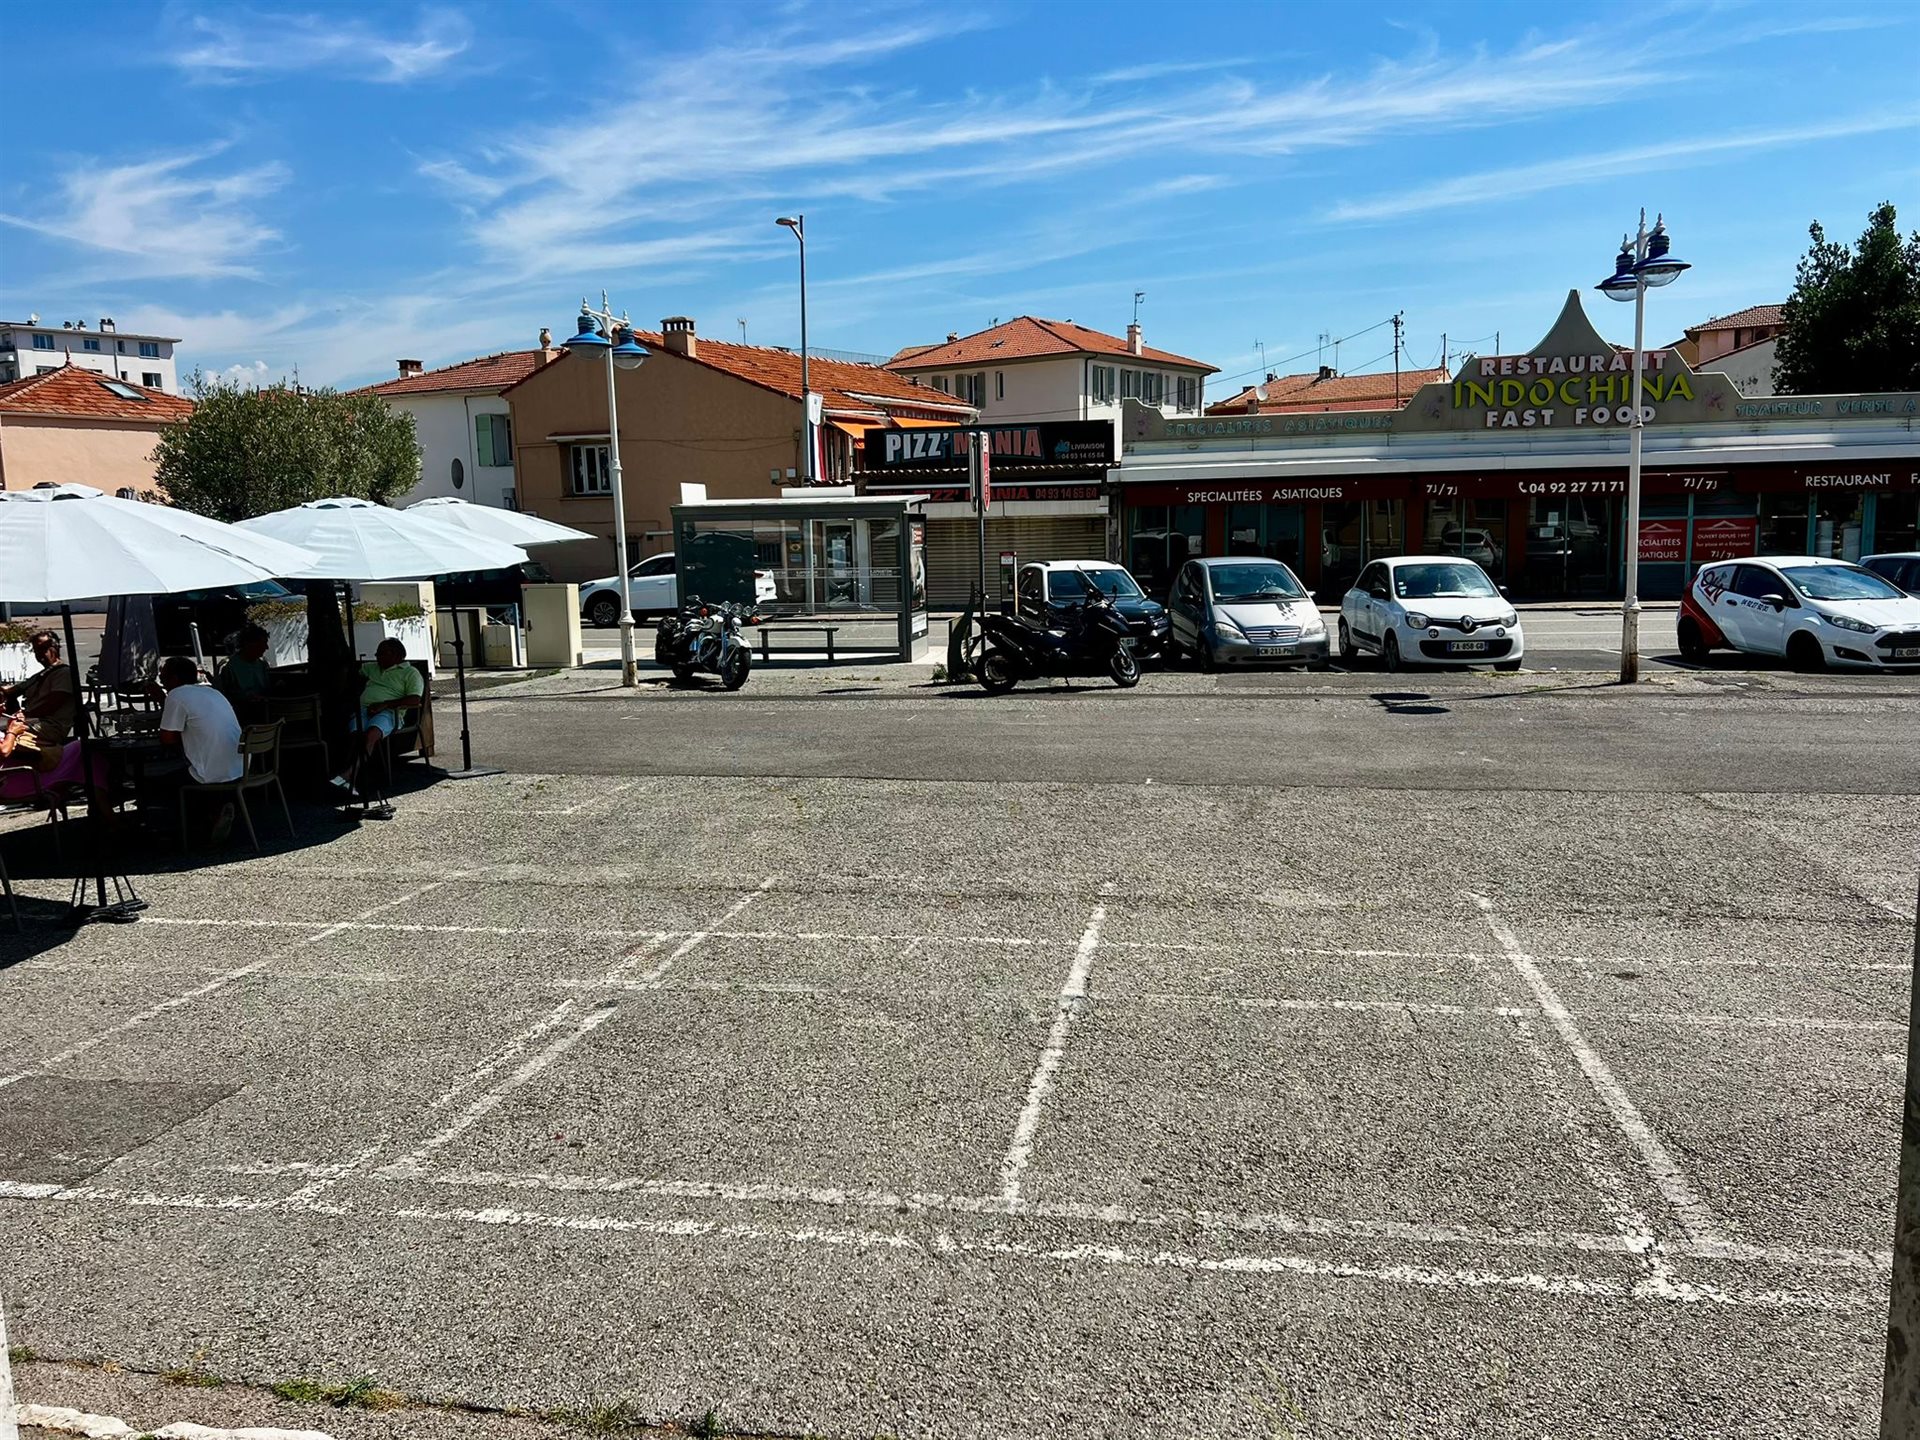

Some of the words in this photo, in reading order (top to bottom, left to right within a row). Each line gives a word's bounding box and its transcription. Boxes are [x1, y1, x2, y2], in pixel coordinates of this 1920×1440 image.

[1452, 373, 1695, 409] INDOCHINA
[1735, 401, 1824, 416] TRAITEUR
[1837, 400, 1895, 414] VENTE
[1284, 415, 1393, 432] ASIATIQUES
[1486, 409, 1554, 427] FAST
[1575, 406, 1656, 425] FOOD
[885, 432, 950, 462] PIZZ'
[953, 429, 1042, 457] MNIA
[1071, 442, 1105, 450] LIVRAISON
[1529, 482, 1545, 493] 04
[1550, 482, 1566, 493] 92
[1570, 482, 1587, 493] 27
[1591, 481, 1606, 492] 71
[1609, 481, 1625, 492] 71
[1805, 473, 1892, 487] RESTAURANT
[1035, 488, 1046, 499] 04
[1047, 488, 1059, 499] 93
[1060, 488, 1072, 499] 14
[1187, 489, 1262, 502] SPECIALITÉES
[1272, 487, 1343, 500] ASIATIQUES
[1637, 550, 1679, 559] SIATIQUES
